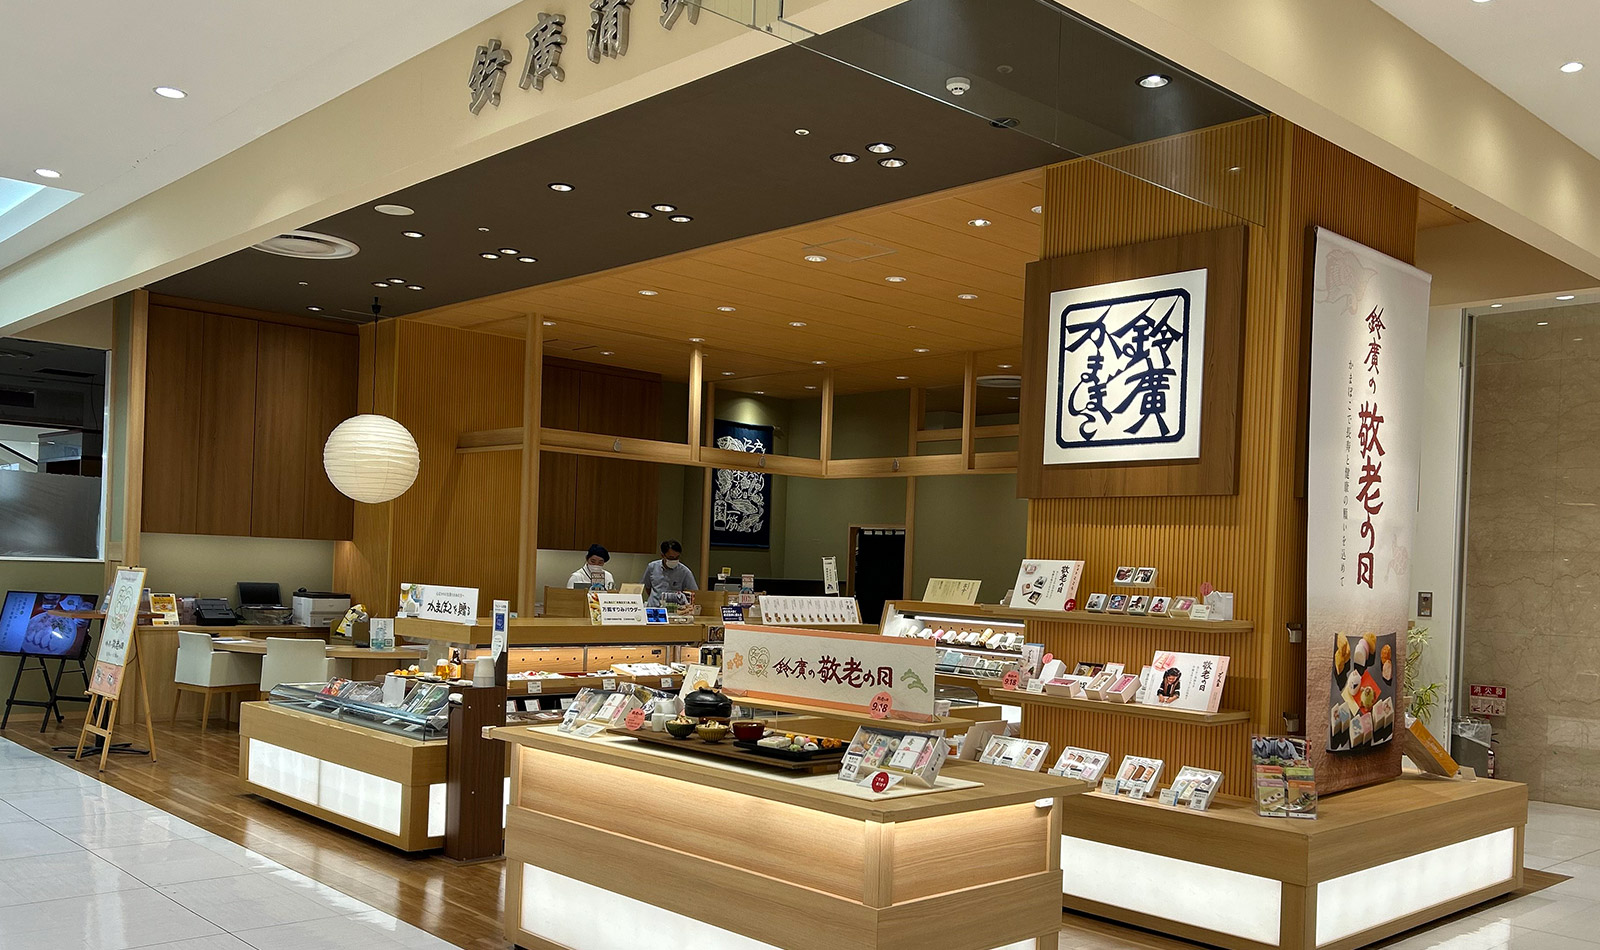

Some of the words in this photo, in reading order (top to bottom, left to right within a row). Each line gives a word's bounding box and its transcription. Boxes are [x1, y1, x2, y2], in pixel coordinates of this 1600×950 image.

[1110, 295, 1184, 436] 鈴廣
[1356, 304, 1387, 589] 鈴廣の敬老の日
[427, 600, 471, 616] かまぼこを贈る
[772, 655, 893, 688] 鈴廣の敬老の日
[871, 702, 888, 712] 9.18
